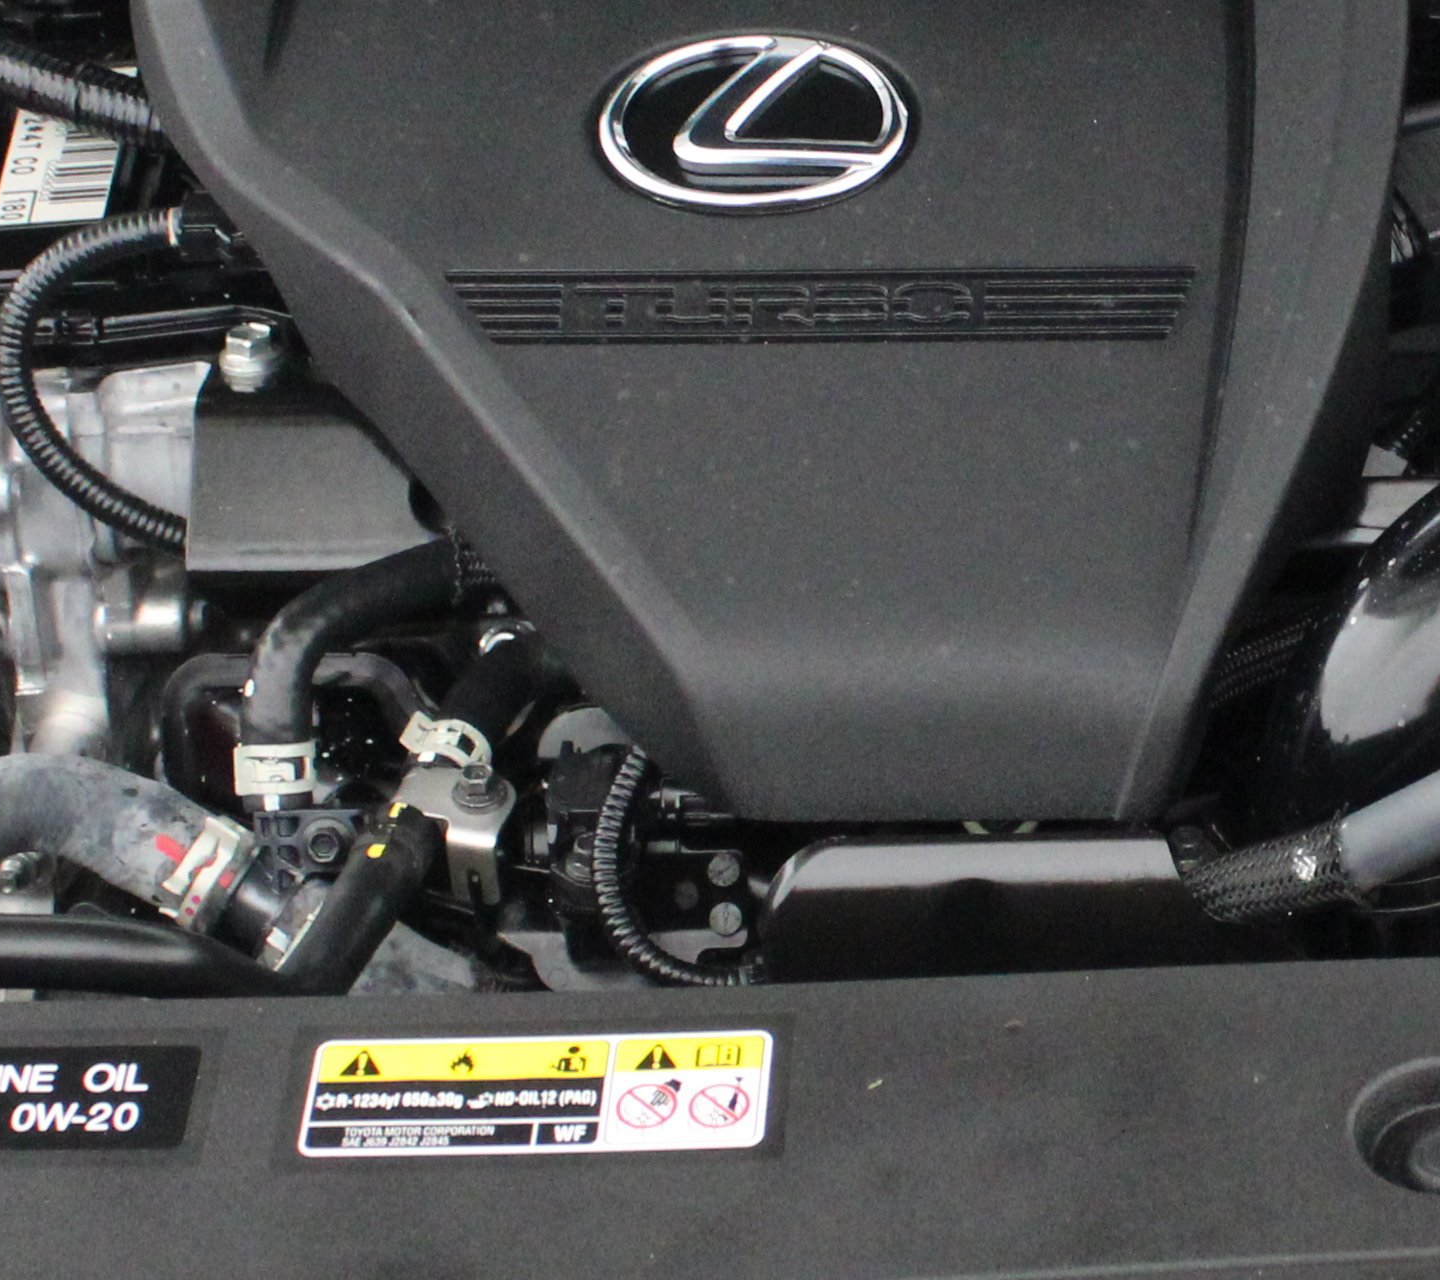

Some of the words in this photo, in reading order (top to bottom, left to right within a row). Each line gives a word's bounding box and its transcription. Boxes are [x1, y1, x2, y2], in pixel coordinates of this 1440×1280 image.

[0, 197, 27, 221] 180
[573, 281, 973, 327] TURBO
[82, 1062, 149, 1093] OIL
[335, 1092, 400, 1111] R-1234yf
[559, 1089, 597, 1107] (PAG)
[10, 1101, 140, 1133] 0W-20
[341, 1137, 361, 1148] SAE
[344, 1127, 383, 1137] TOYOTA
[385, 1126, 421, 1137] MOTOR
[423, 1125, 496, 1136] CORPORATION
[553, 1123, 587, 1142] WF
